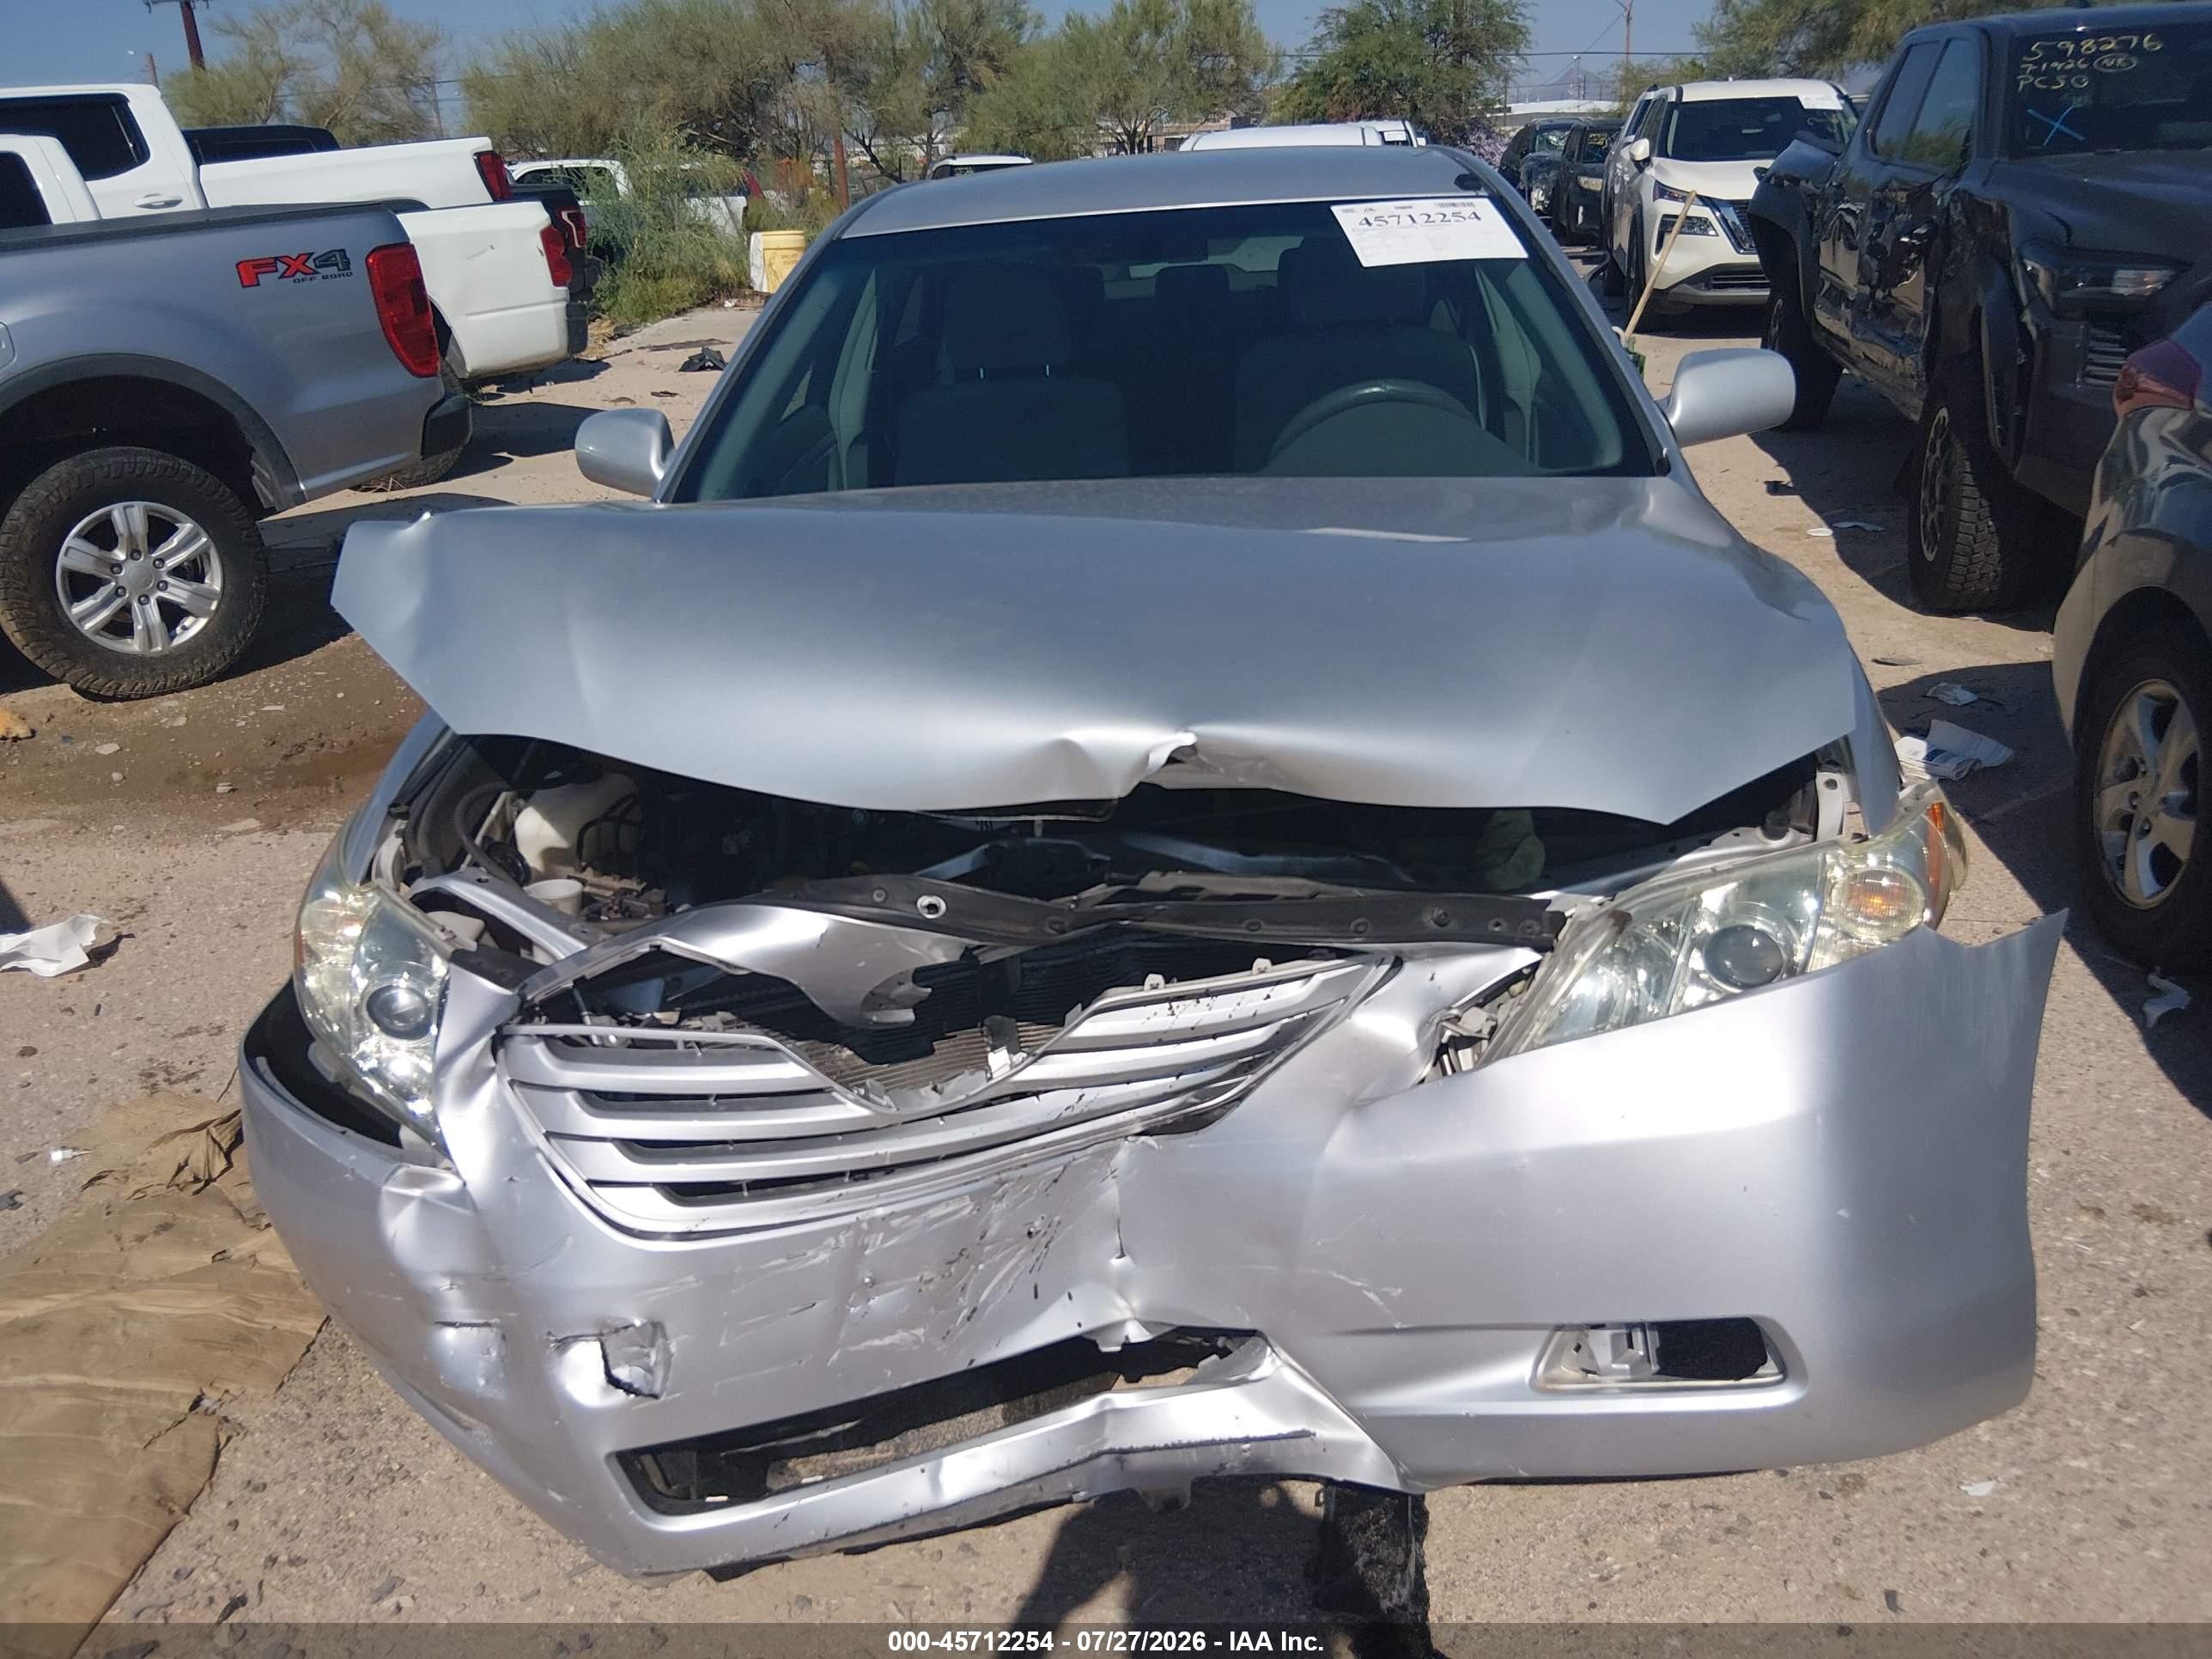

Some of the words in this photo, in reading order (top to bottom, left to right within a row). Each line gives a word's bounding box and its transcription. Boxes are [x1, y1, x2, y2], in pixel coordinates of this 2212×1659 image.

[2022, 33, 2164, 60] 598276
[1358, 211, 1482, 228] 45712254
[235, 248, 351, 288] FX4
[293, 276, 317, 284] OFF
[321, 271, 353, 280] ROAD
